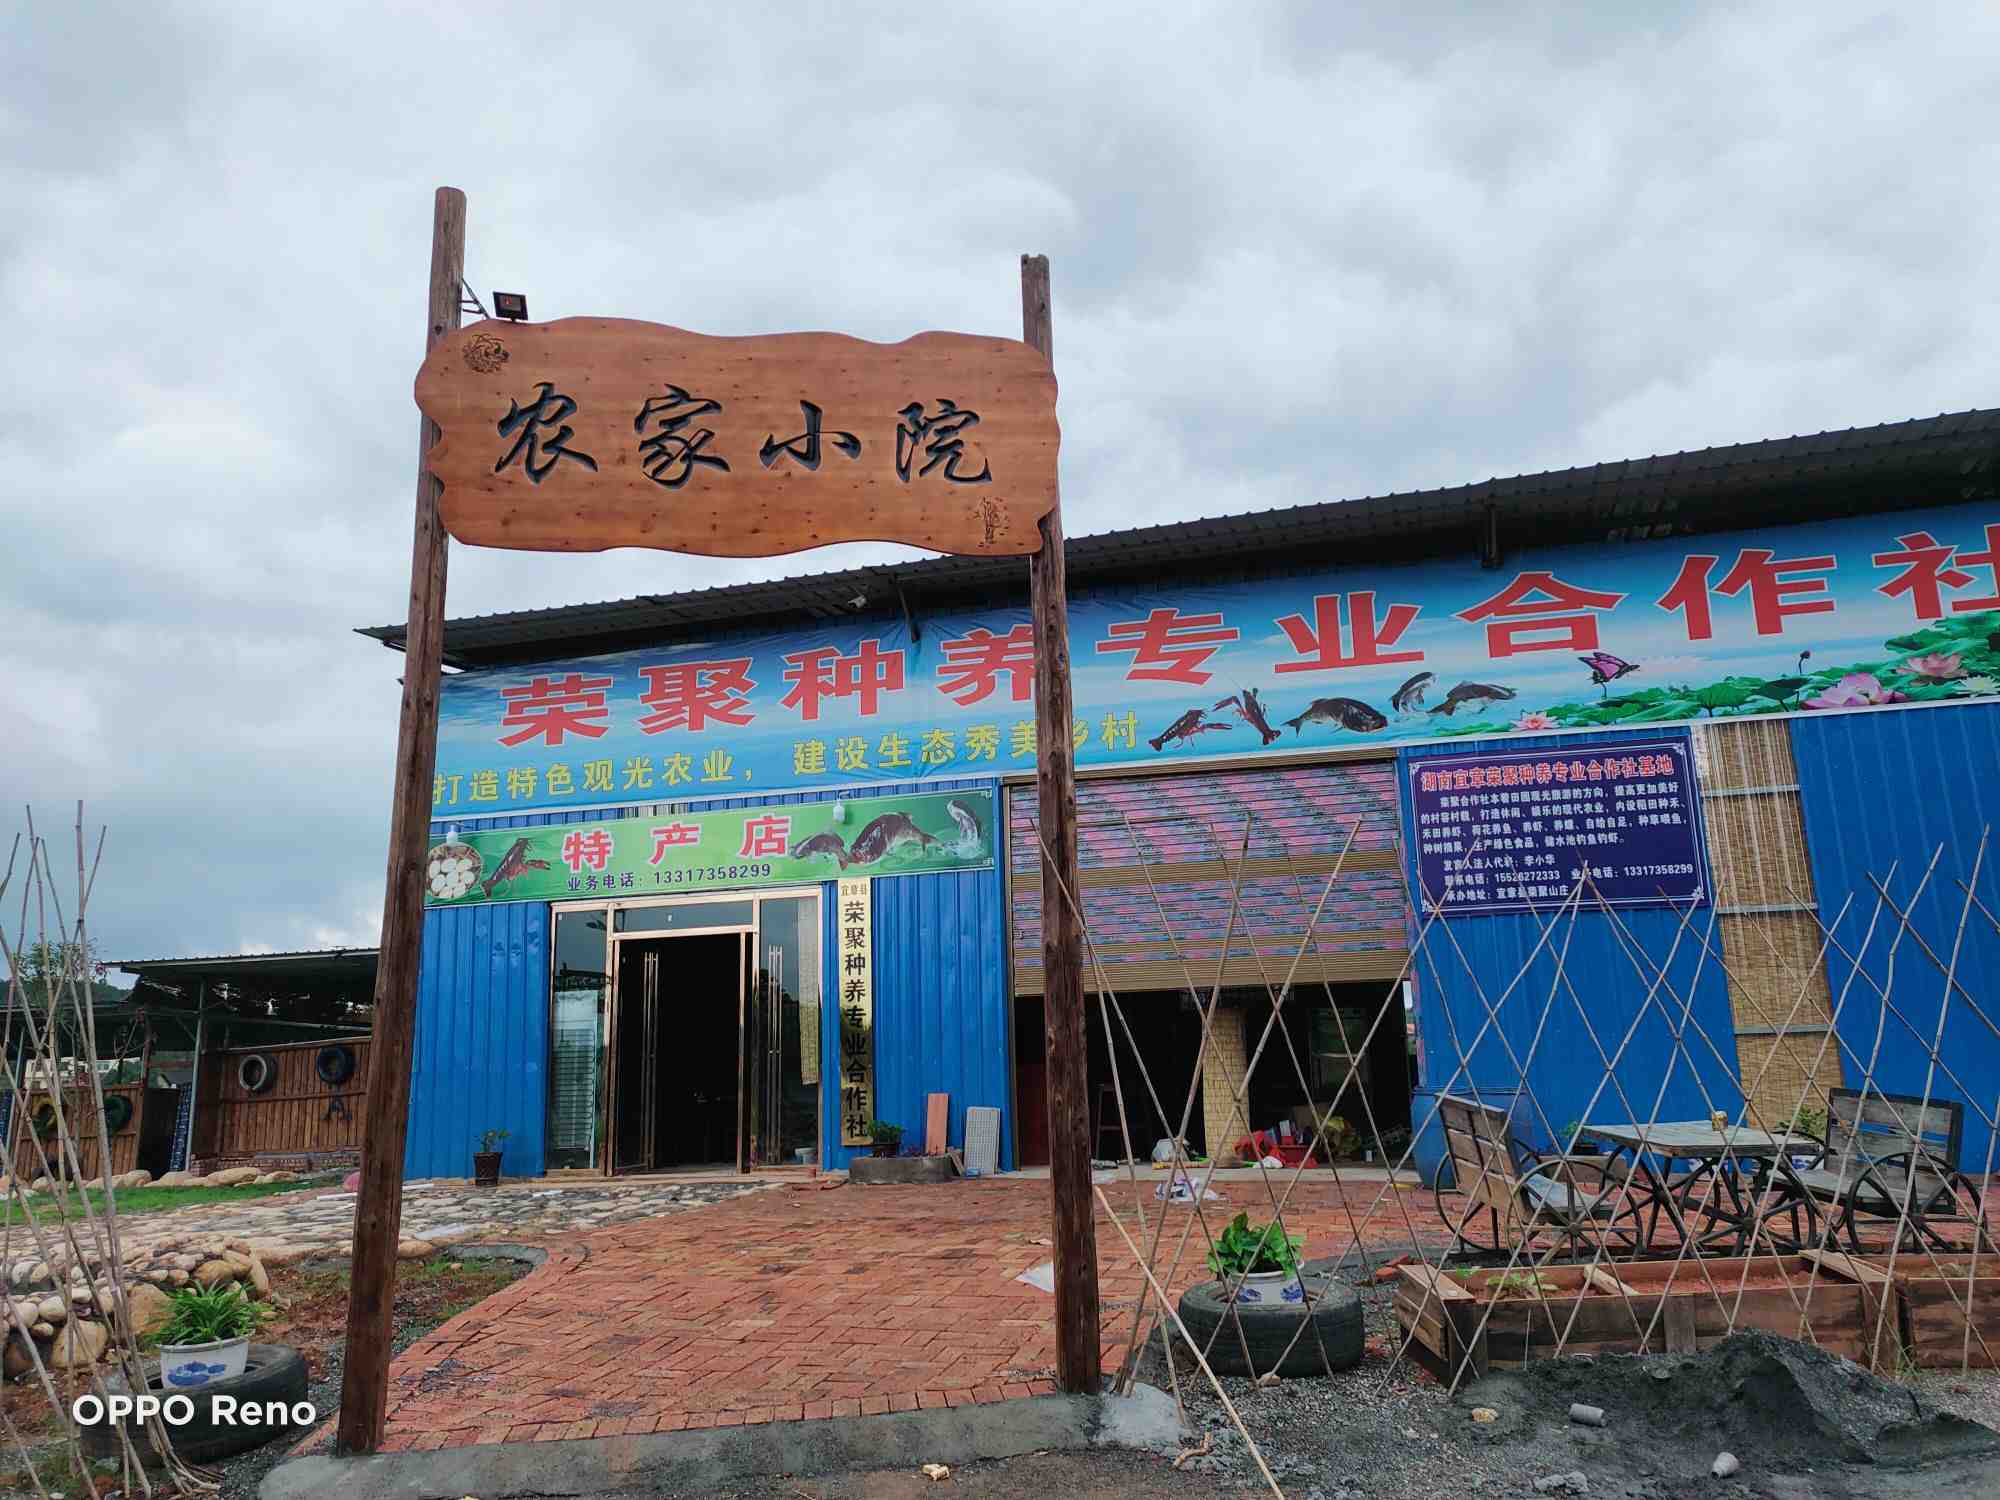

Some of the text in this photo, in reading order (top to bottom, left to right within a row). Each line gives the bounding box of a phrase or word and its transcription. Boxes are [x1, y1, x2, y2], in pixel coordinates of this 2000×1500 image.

[493, 381, 993, 490] 农家小院
[1420, 754, 1675, 792] 湖南宜章荣聚种养专业合作社基地
[561, 813, 791, 872] 特产店
[844, 901, 869, 1140] 荣聚种养专业合作社
